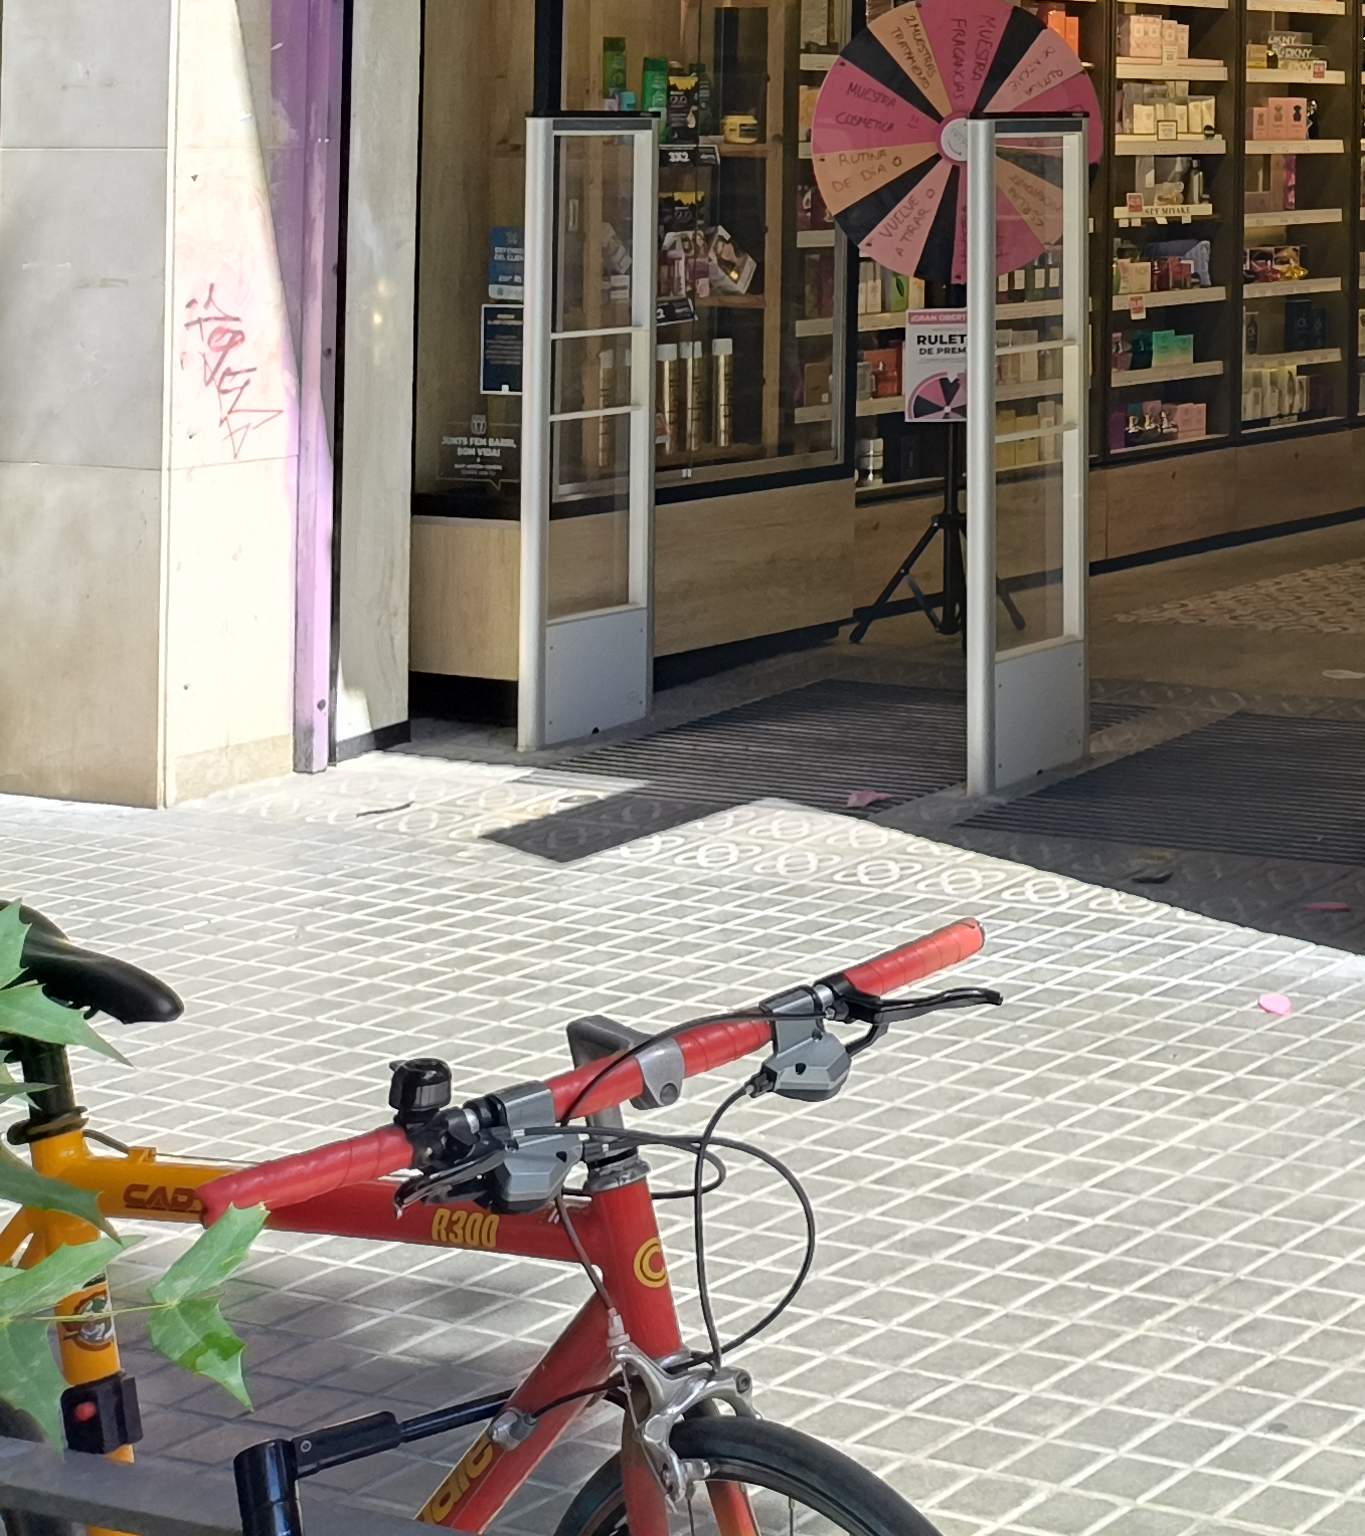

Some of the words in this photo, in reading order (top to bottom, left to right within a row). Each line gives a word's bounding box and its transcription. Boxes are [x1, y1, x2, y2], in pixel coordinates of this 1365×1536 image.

[916, 334, 967, 346] RULET
[919, 347, 934, 355] DE
[431, 1207, 499, 1249] R300
